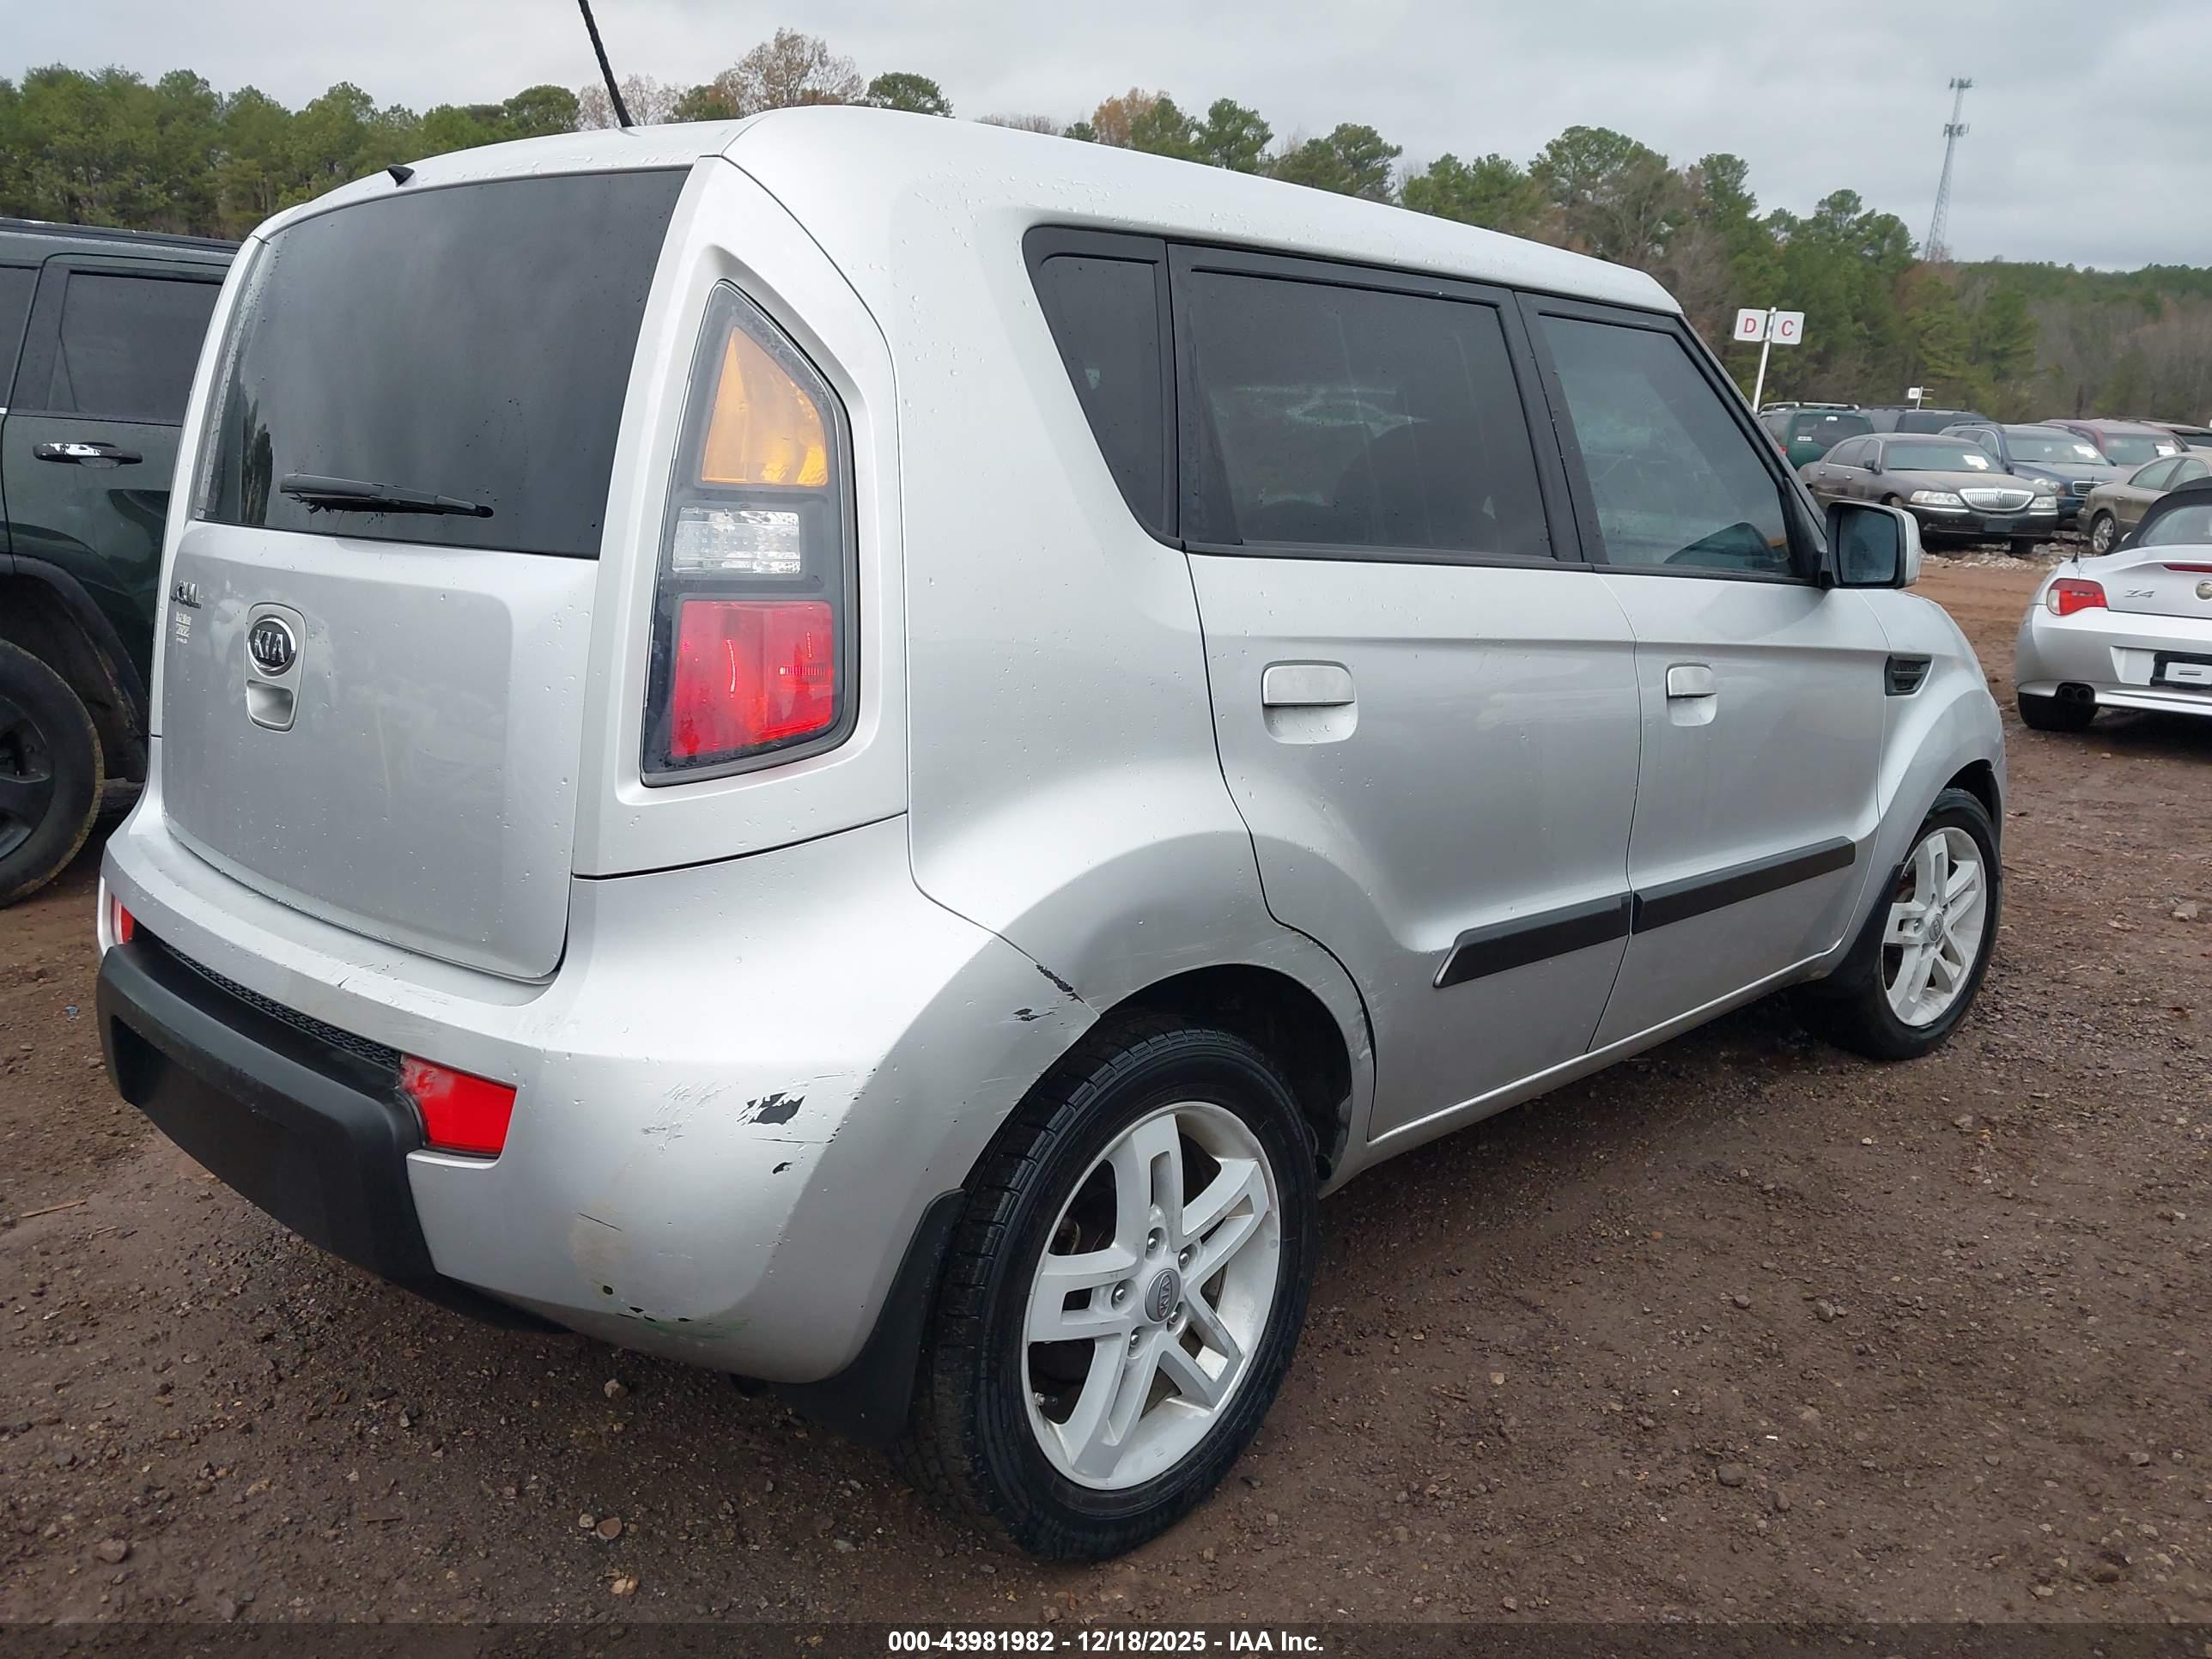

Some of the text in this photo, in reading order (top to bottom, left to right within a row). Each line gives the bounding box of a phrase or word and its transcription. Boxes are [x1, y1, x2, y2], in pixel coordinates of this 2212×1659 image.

[1744, 318, 1757, 333] D
[1781, 320, 1794, 337] C
[254, 629, 285, 663] KIA
